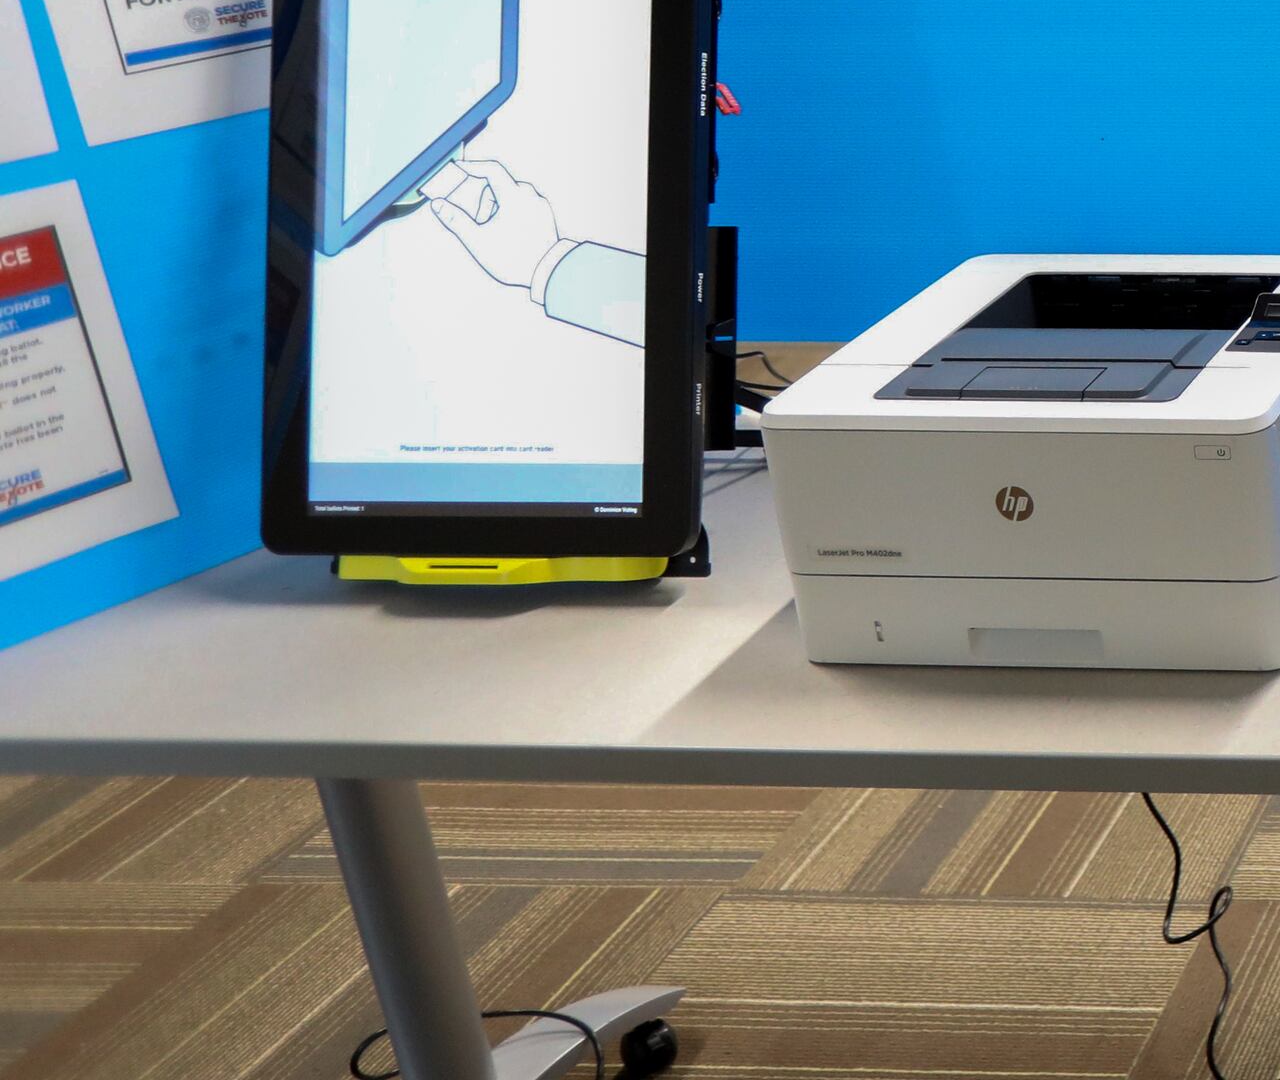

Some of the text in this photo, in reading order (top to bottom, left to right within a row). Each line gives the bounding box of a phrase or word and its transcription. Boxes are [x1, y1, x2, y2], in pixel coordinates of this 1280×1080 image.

[214, 0, 265, 16] SECURE
[1000, 486, 1031, 521] hp
[851, 549, 864, 557] Pro
